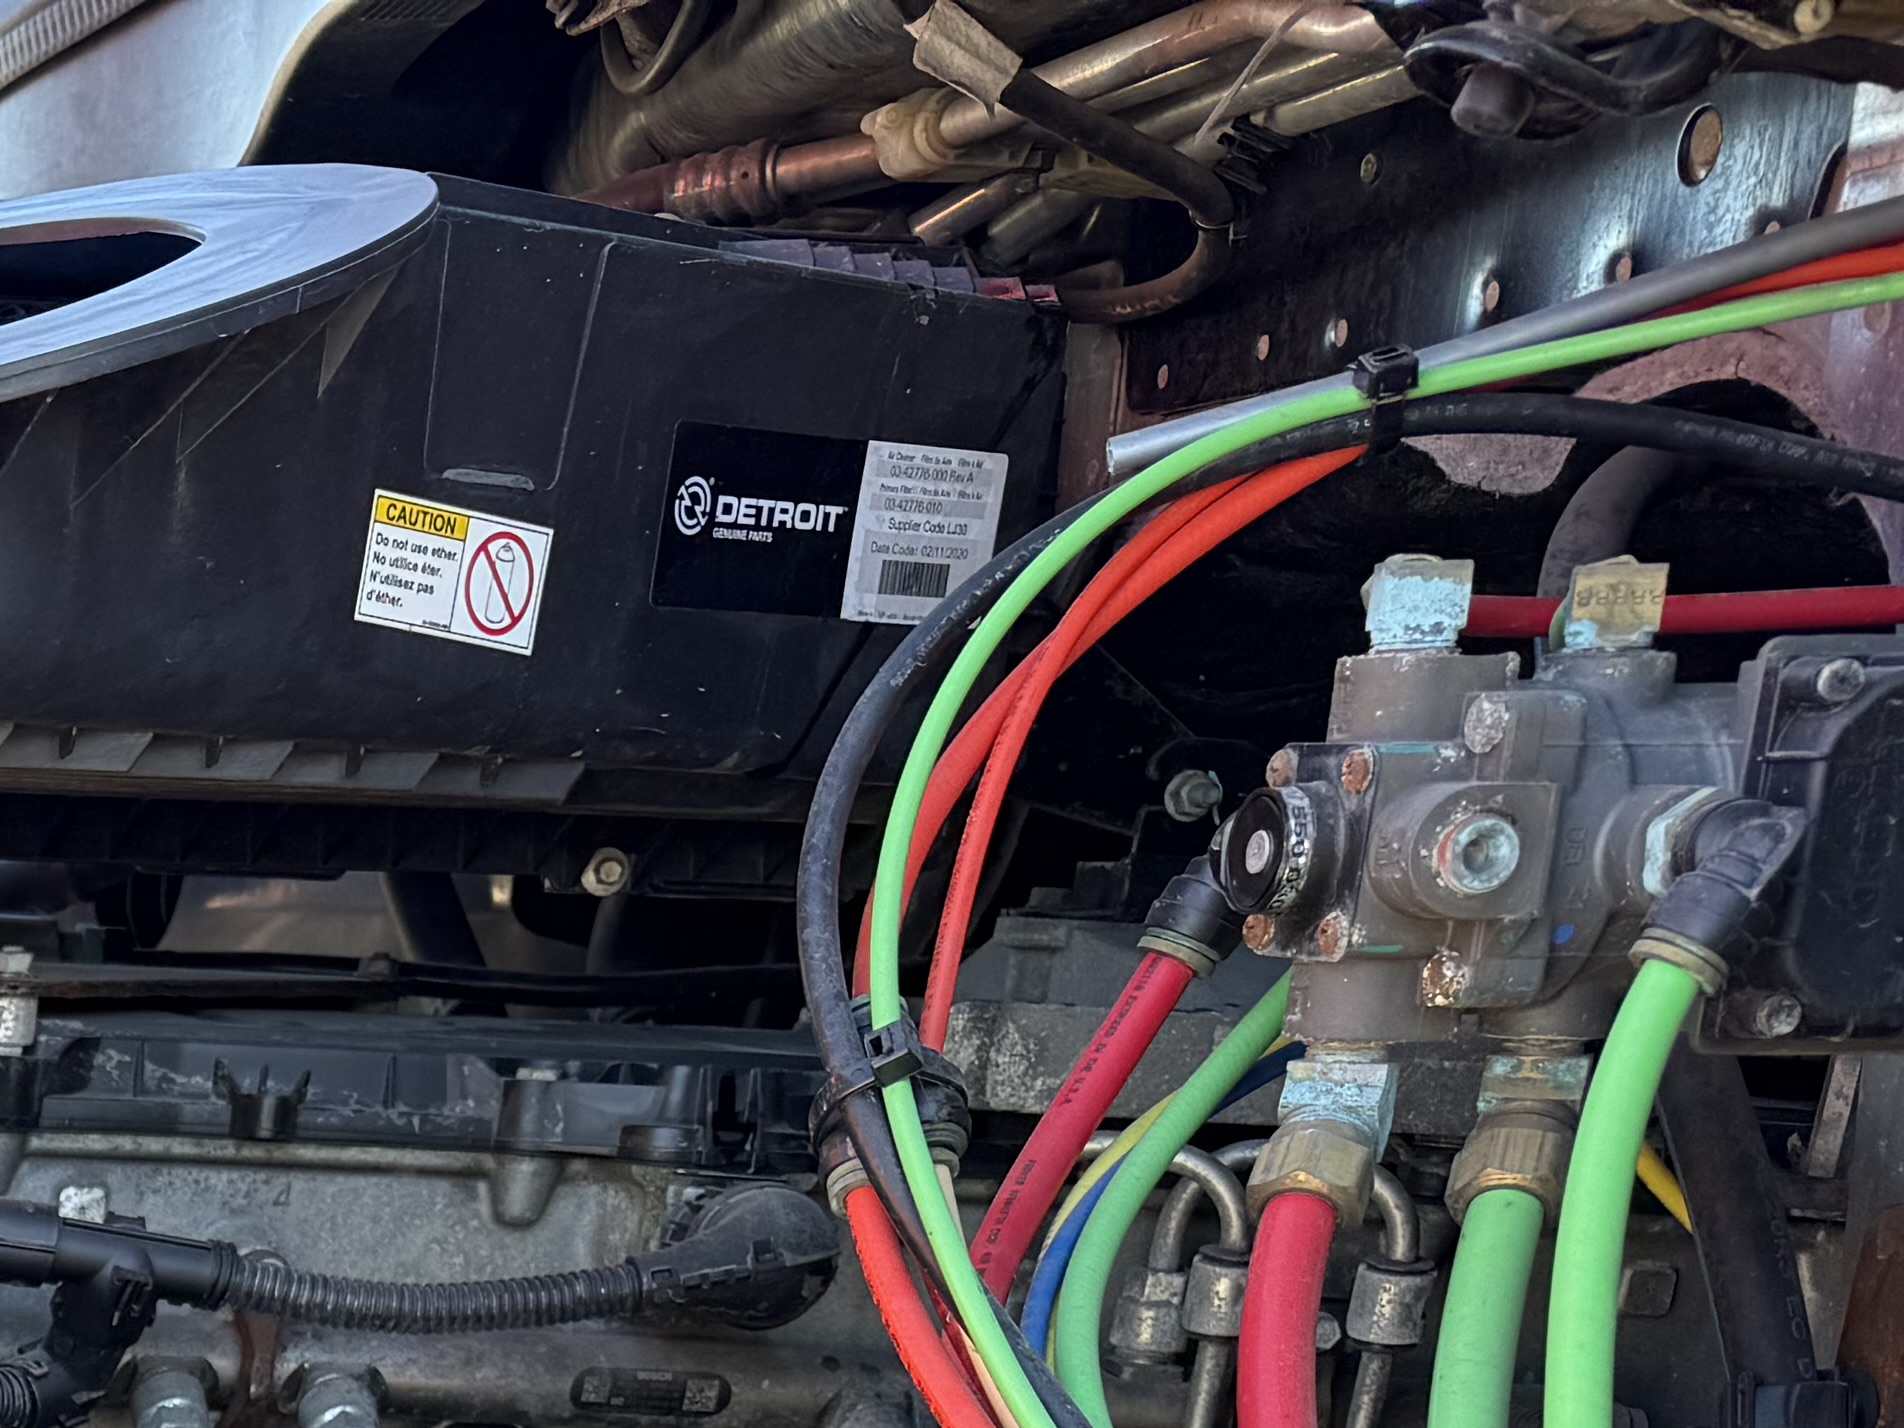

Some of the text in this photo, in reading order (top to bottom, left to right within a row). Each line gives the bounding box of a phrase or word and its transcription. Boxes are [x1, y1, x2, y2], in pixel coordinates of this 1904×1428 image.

[386, 503, 457, 536] CAUTION
[715, 495, 844, 532] DETROIT
[375, 532, 458, 562] Do not use ether.
[871, 541, 890, 554] Date
[372, 552, 386, 565] No
[416, 582, 435, 596] pas
